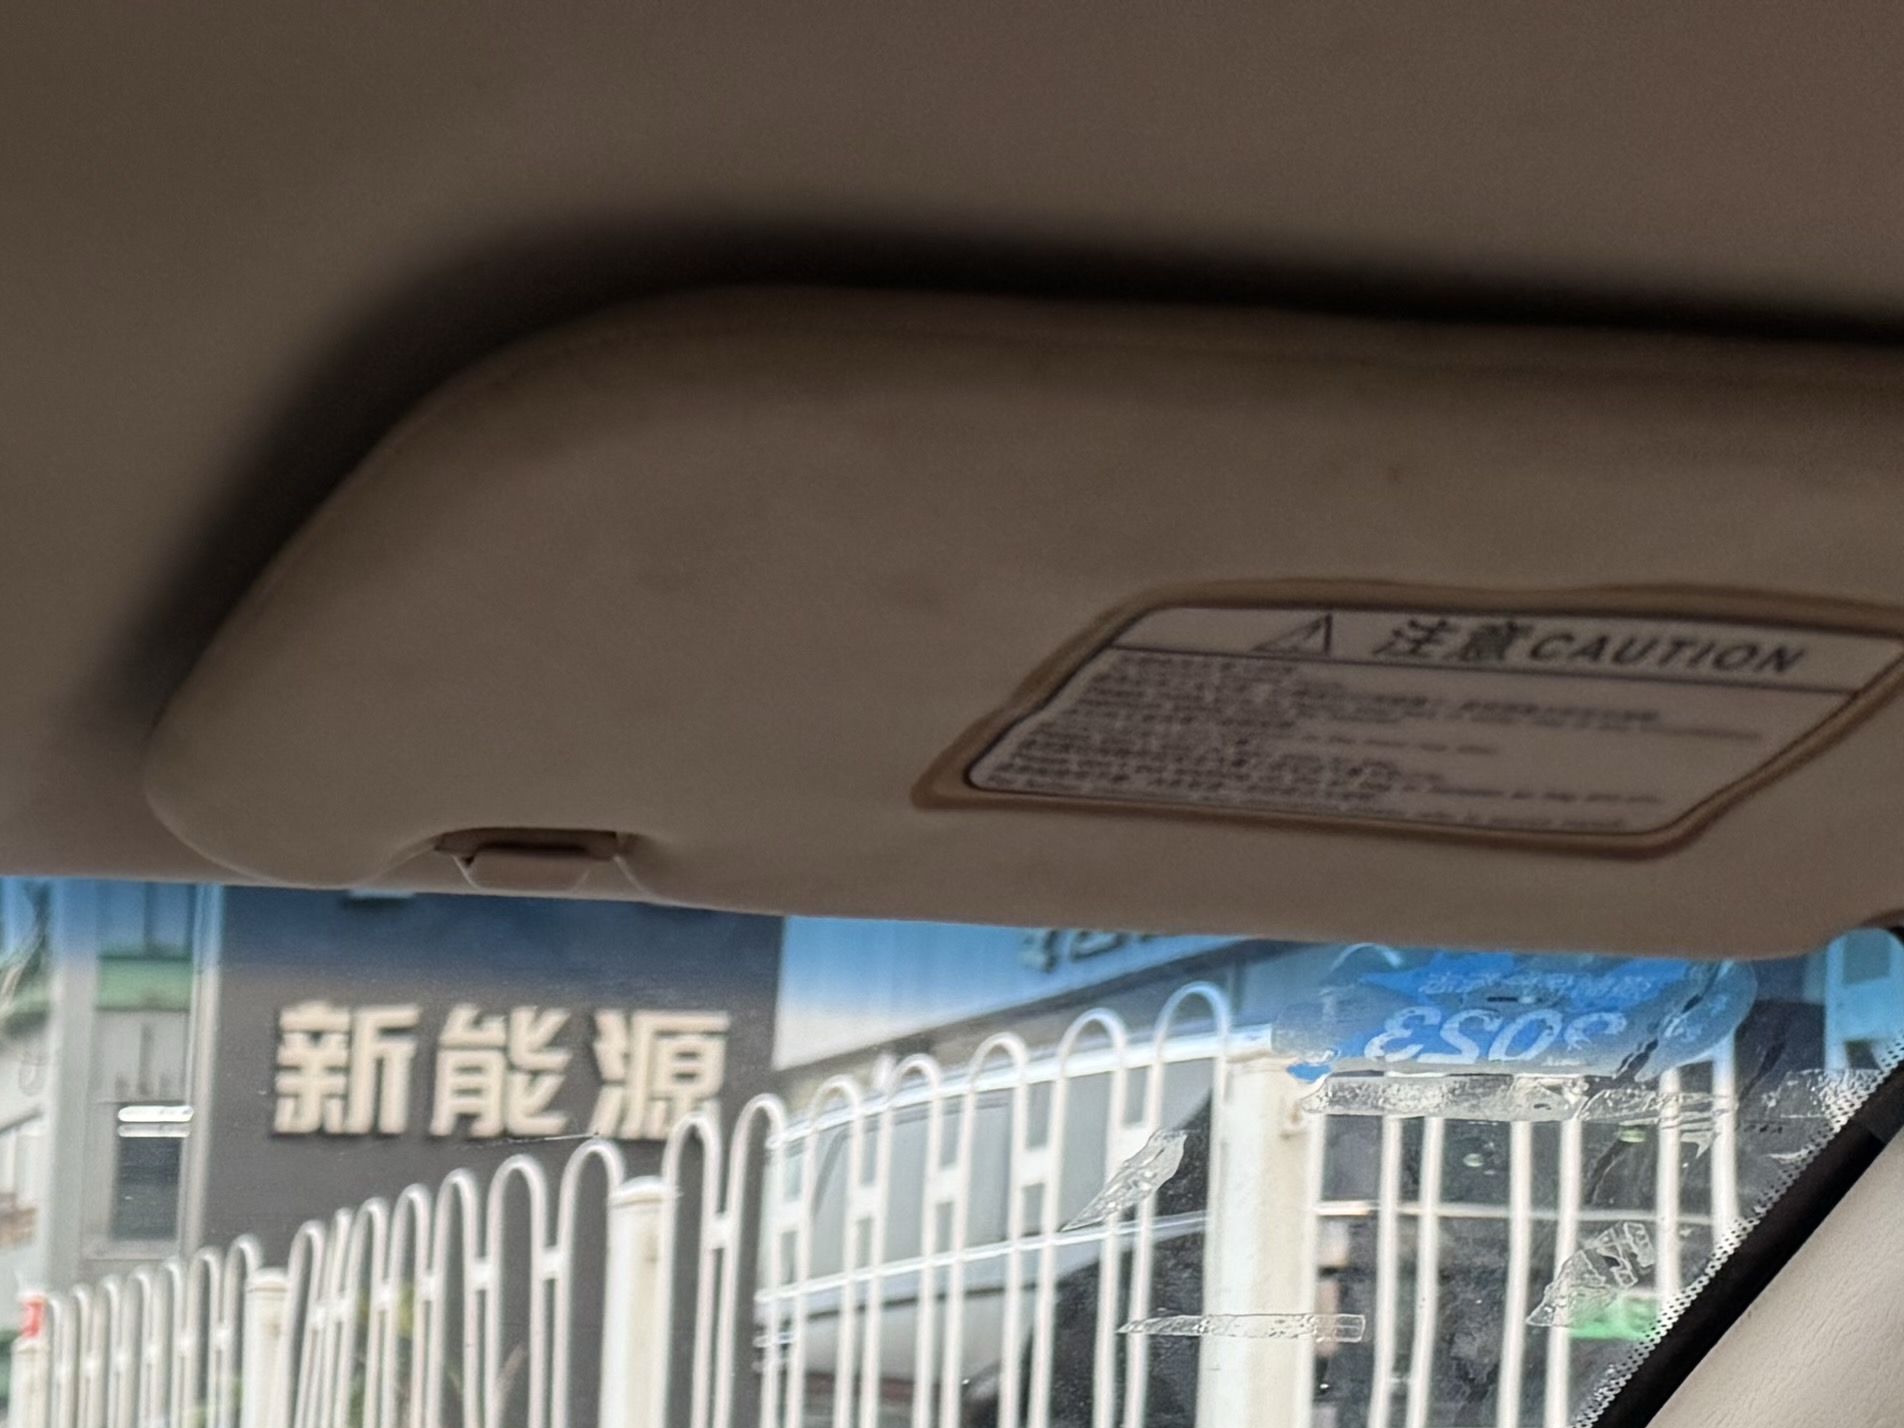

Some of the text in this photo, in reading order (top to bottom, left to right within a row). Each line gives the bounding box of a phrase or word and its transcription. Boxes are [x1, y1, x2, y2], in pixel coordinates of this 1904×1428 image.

[1374, 619, 1534, 663] 注意
[1529, 632, 1806, 673] CAUTION
[273, 1002, 732, 1141] 新能源
